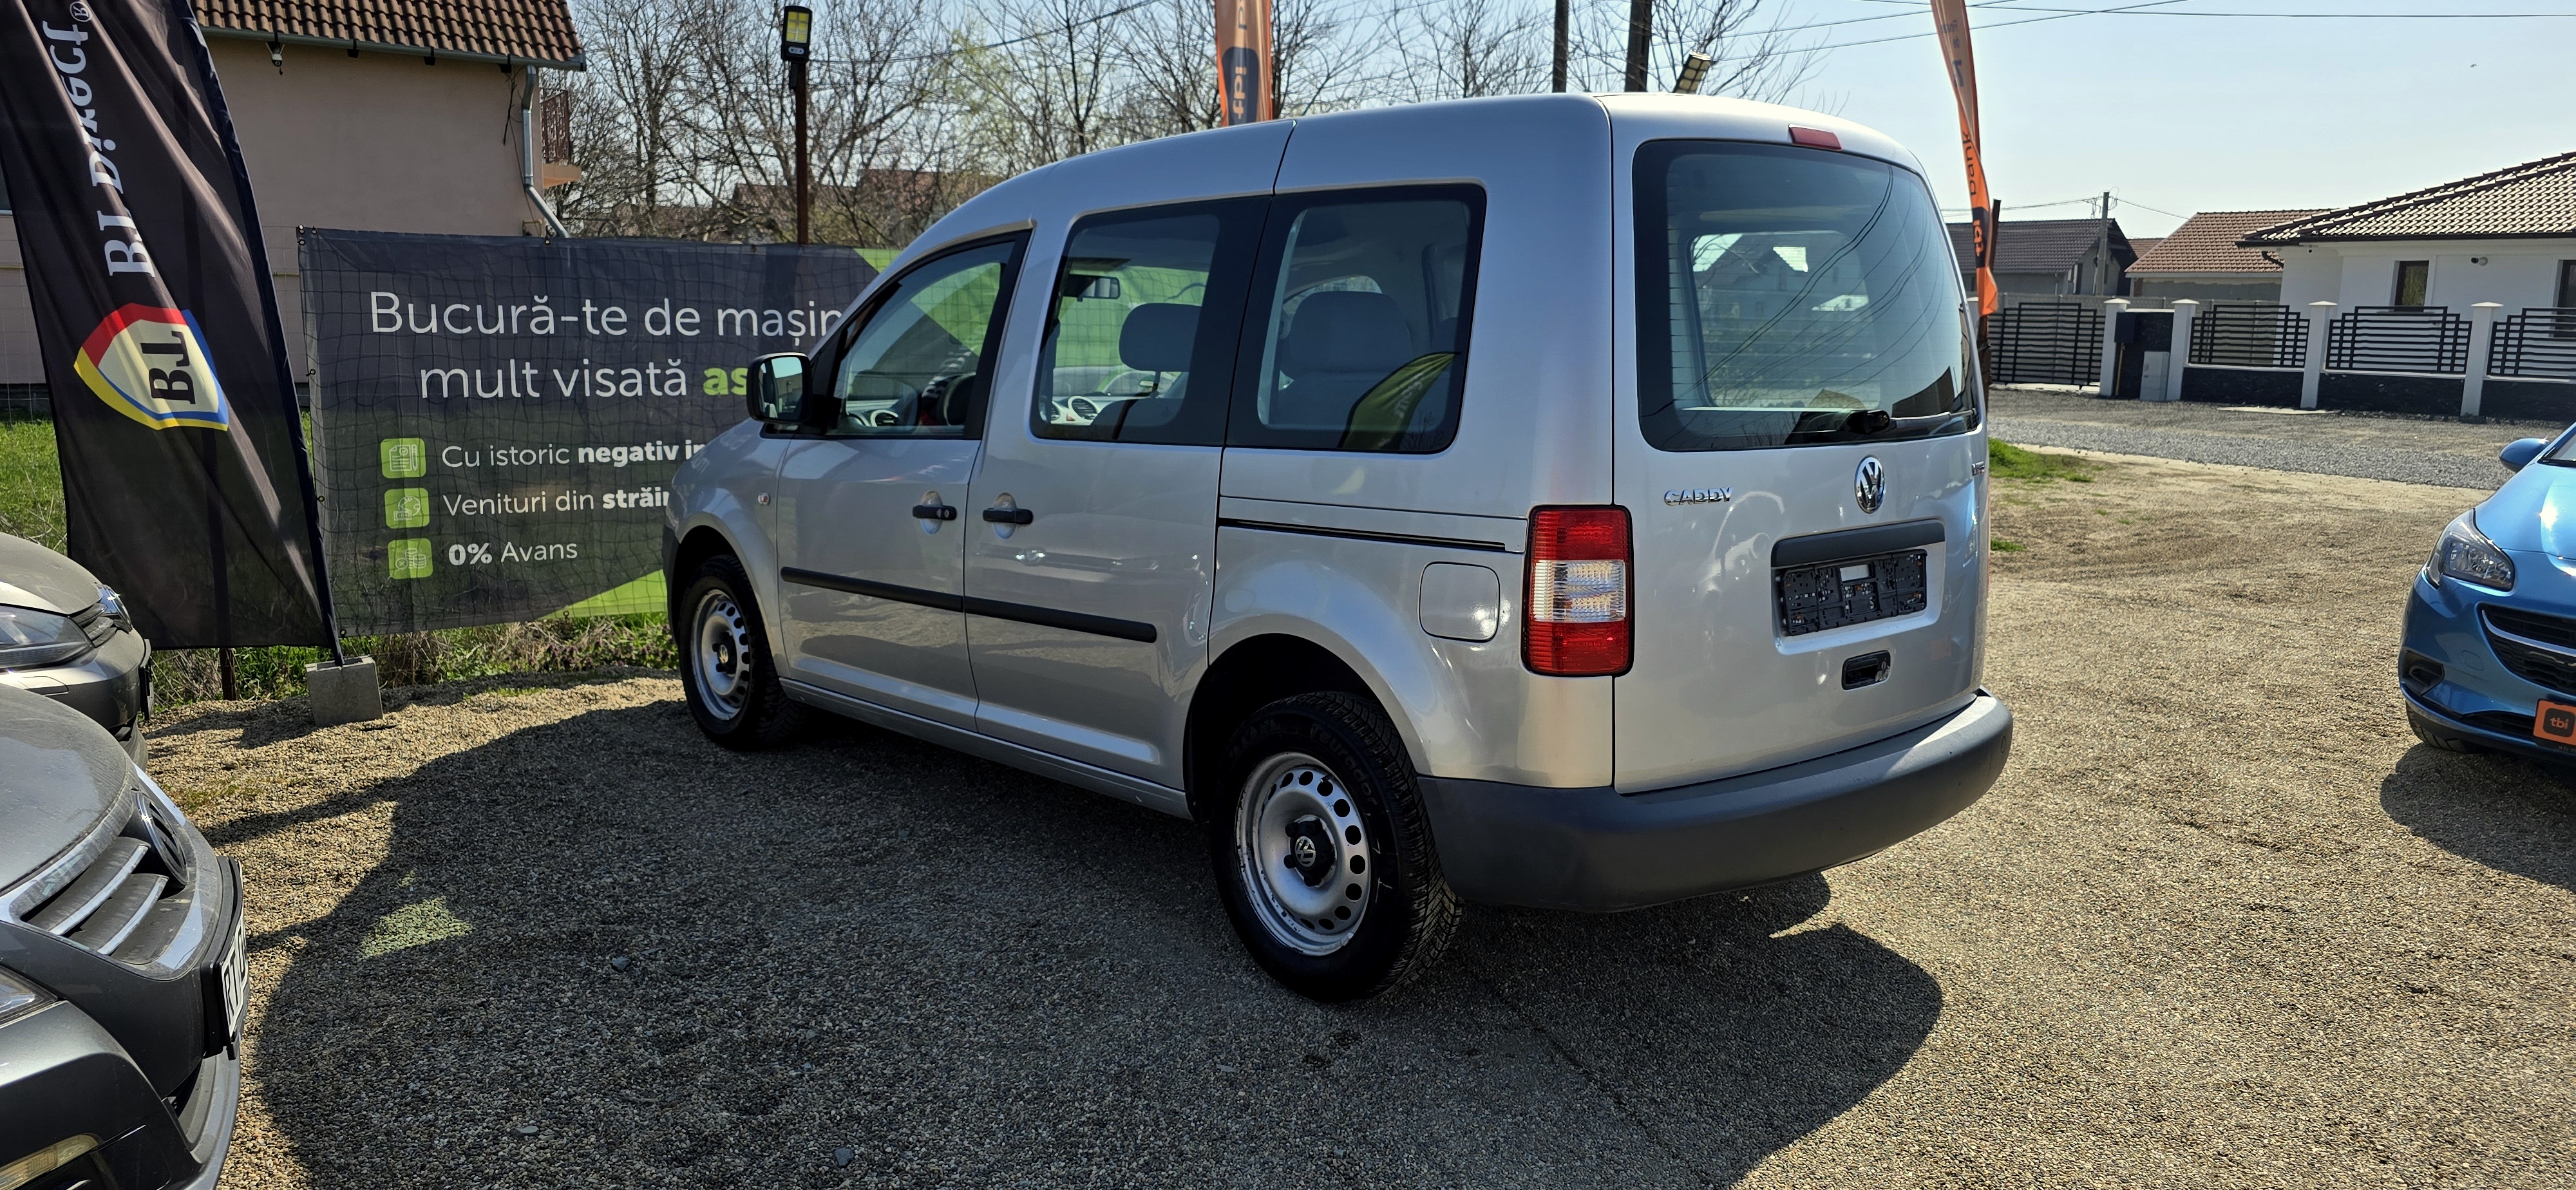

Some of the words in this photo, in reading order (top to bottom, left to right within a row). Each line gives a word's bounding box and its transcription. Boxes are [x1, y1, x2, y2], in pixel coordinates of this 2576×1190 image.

[370, 290, 628, 336] Bucură-te
[644, 297, 701, 336] de
[420, 359, 540, 399] mult
[553, 357, 687, 397] visată
[442, 445, 480, 468] Cu
[489, 442, 570, 467] istoric
[578, 440, 679, 468] negativ
[442, 490, 546, 516] Venituri
[555, 489, 594, 511] din
[1663, 487, 1734, 505] CADDY
[448, 543, 493, 565] 0%
[500, 541, 578, 563] Avans
[2550, 717, 2569, 729] tbi
